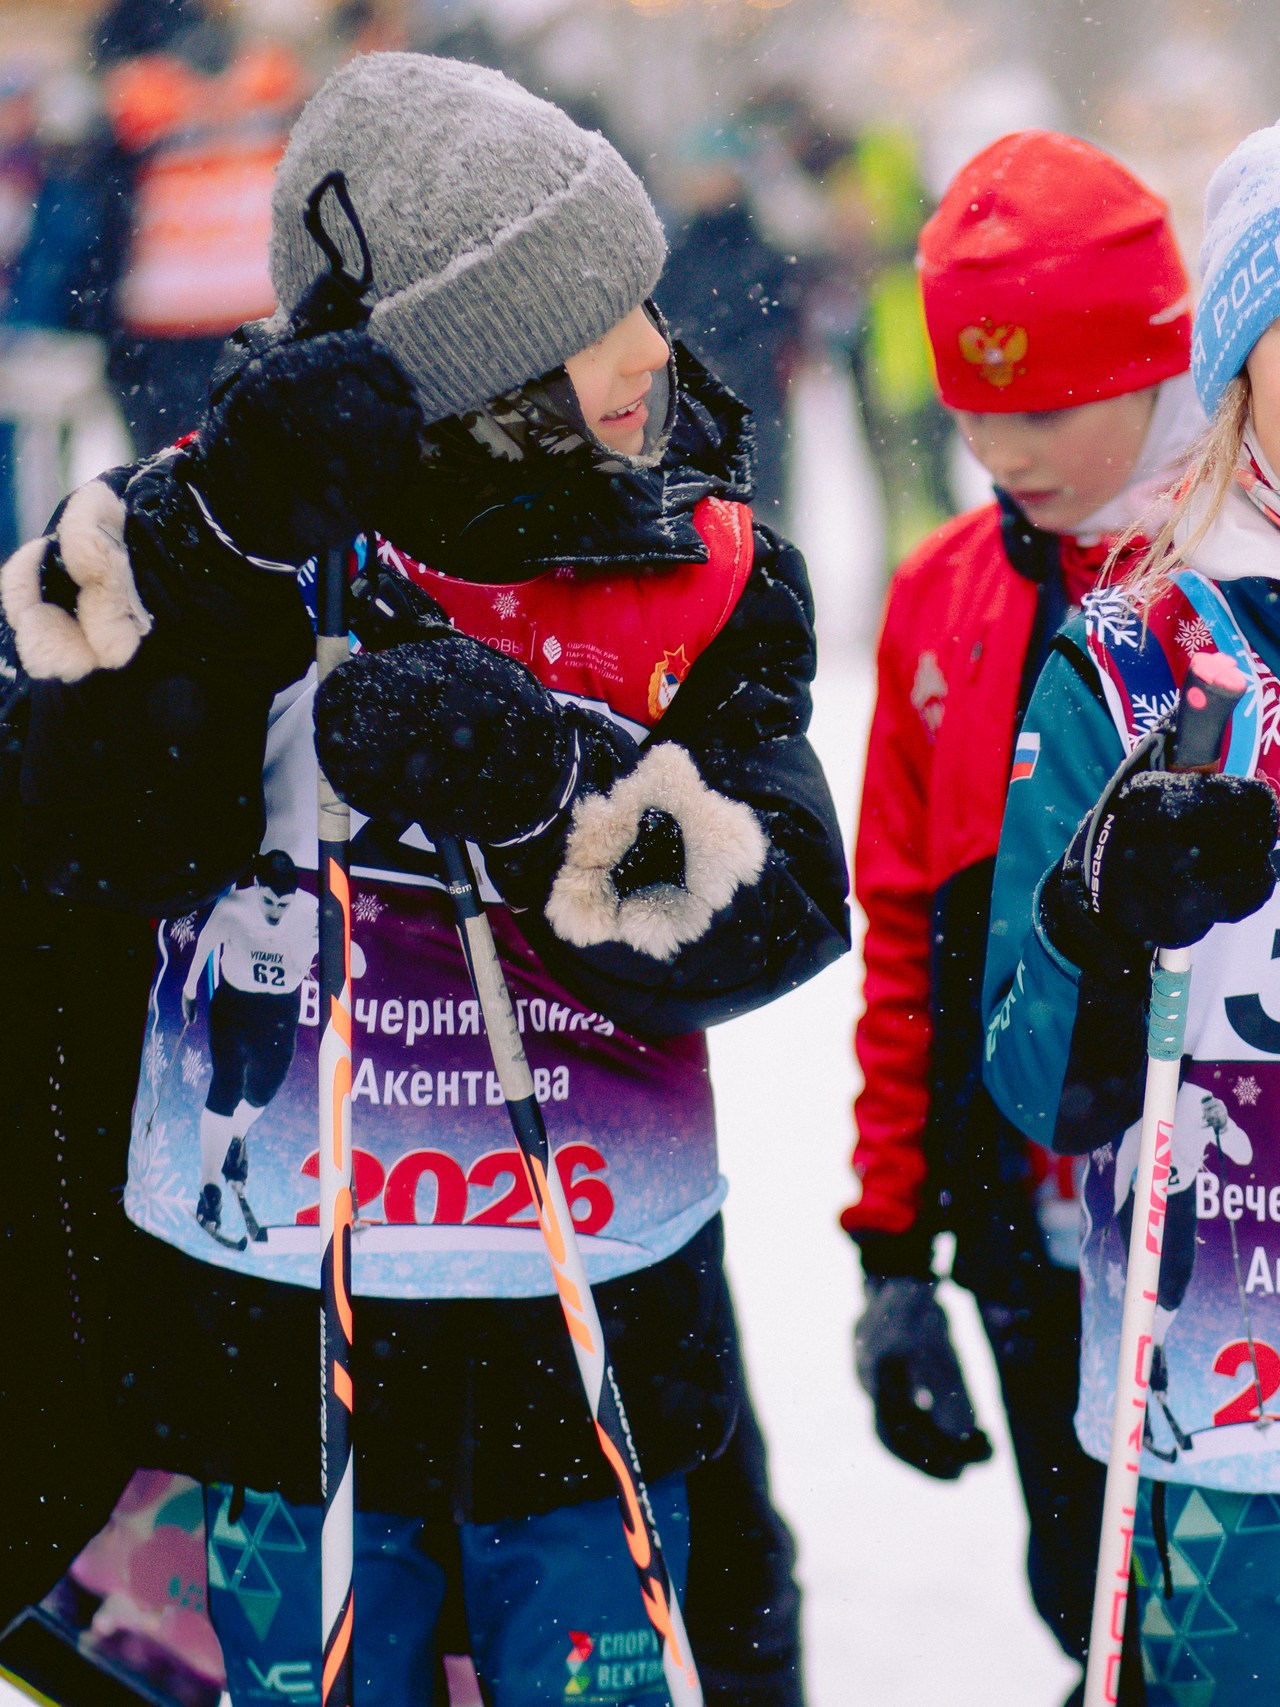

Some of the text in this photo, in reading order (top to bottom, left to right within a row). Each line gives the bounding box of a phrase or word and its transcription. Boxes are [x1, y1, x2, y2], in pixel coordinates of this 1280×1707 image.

[1091, 812, 1116, 914] NORDSKI
[253, 963, 286, 987] 62
[298, 980, 487, 1046] Вчерня
[350, 1057, 570, 1107] Акентьва
[294, 1140, 615, 1237] 2026
